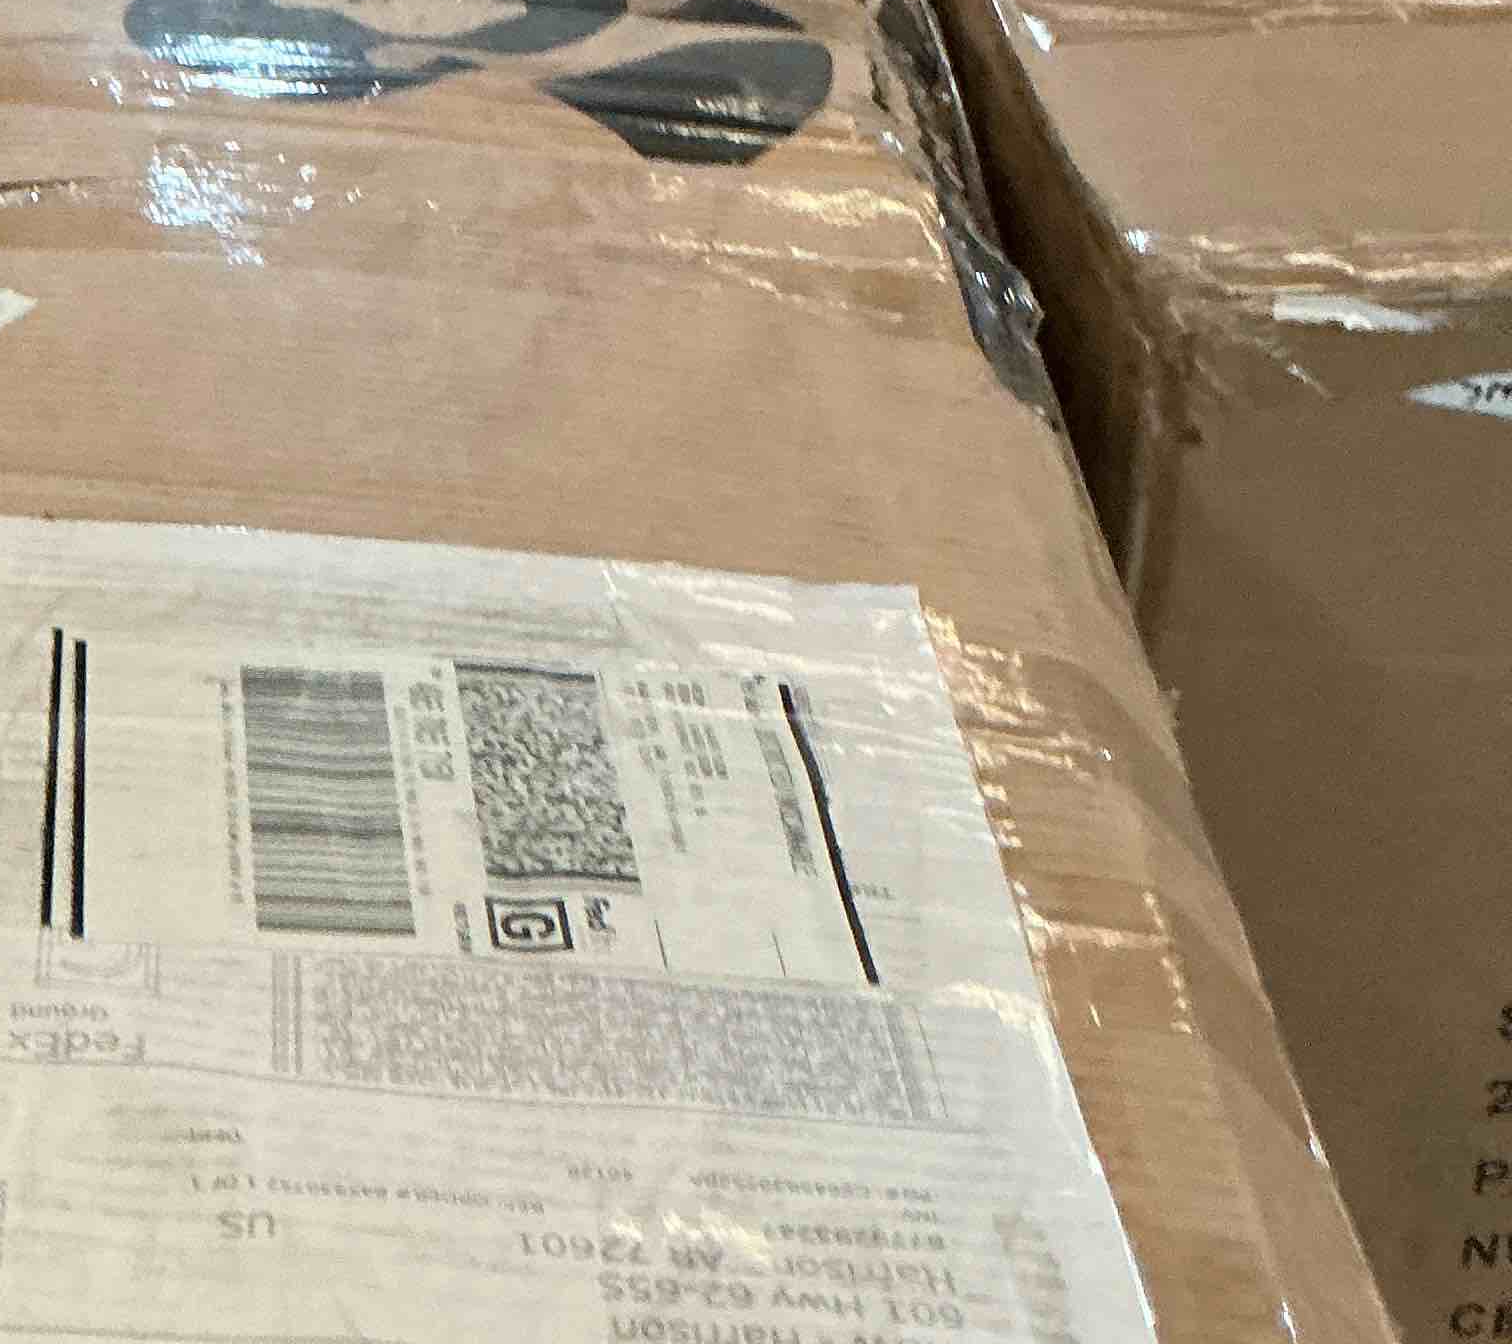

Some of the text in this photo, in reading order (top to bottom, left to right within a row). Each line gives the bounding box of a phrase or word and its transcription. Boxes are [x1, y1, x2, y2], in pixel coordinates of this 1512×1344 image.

[8, 1032, 147, 1066] FedEx
[217, 1212, 277, 1240] US
[771, 1285, 870, 1321] Hwy
